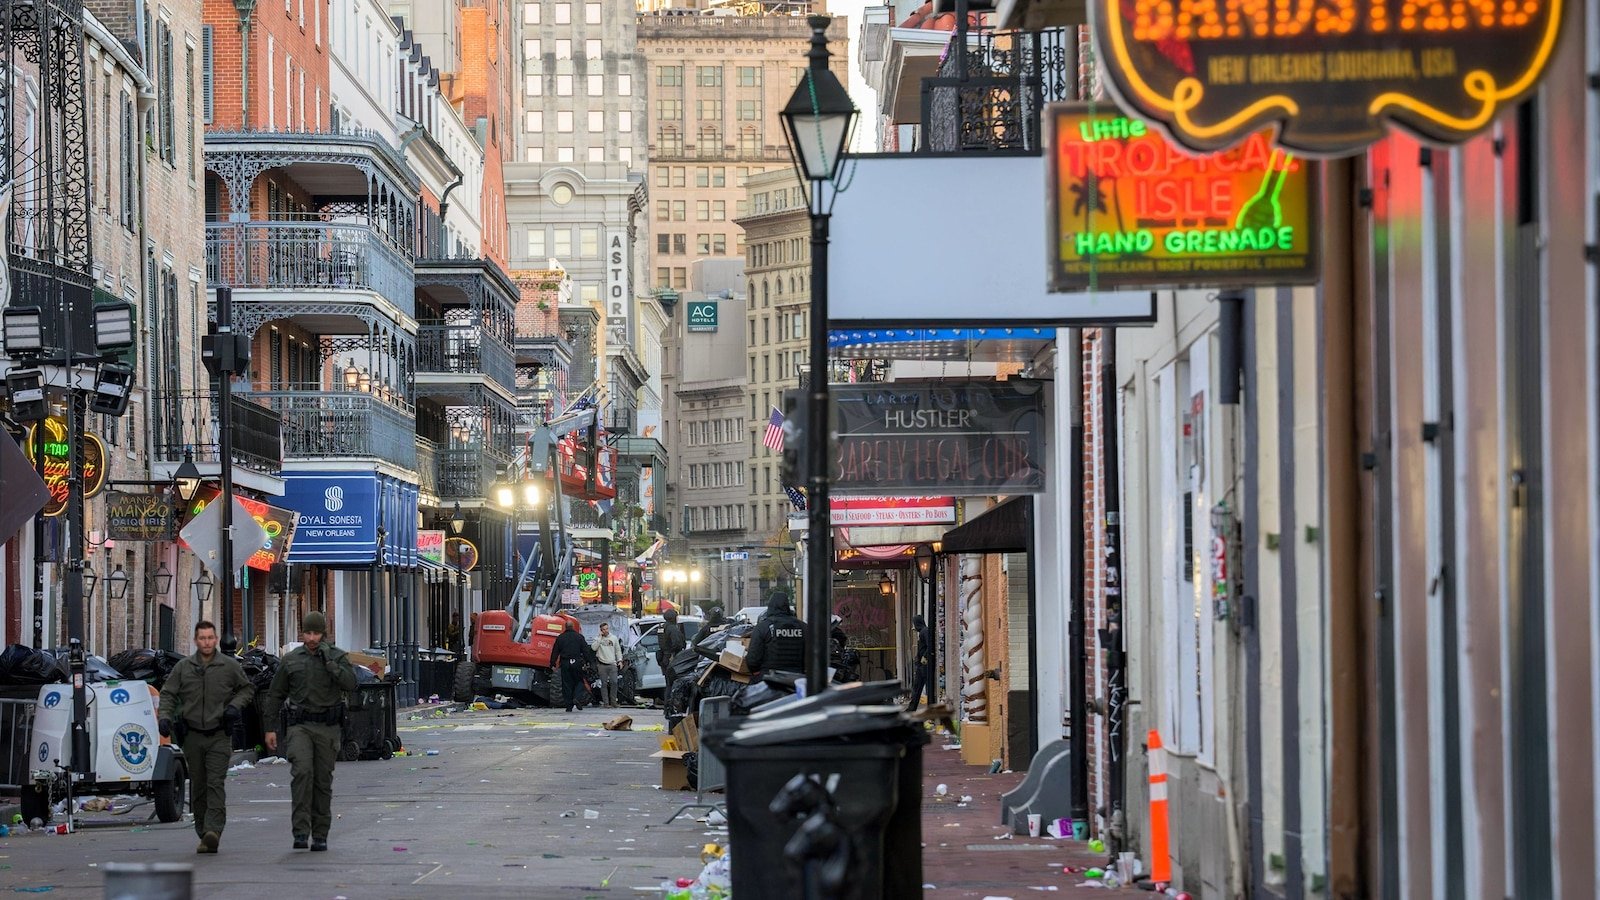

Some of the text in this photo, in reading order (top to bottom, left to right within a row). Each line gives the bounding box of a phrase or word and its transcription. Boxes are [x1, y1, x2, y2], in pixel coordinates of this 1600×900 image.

[1208, 57, 1246, 84] NEW
[1421, 48, 1457, 77] USA
[1138, 180, 1232, 218] ISLE
[1076, 227, 1294, 254] HAND GRENADE
[611, 235, 622, 315] ASTOR
[691, 305, 715, 318] AC
[867, 393, 919, 406] LARRY
[49, 444, 69, 456] TAP
[915, 439, 976, 481] LEGAL
[982, 438, 1031, 479] CLUB
[119, 496, 159, 505] MANGO
[110, 504, 169, 518] MANGO
[848, 511, 872, 520] SEAFOOD
[876, 510, 895, 520] STEAKS
[898, 509, 921, 519] OYSTERS
[112, 517, 167, 526] DAIQUIRIS
[298, 515, 363, 525] OYAL SONESTA
[325, 529, 356, 537] ORLEANS
[776, 628, 802, 638] POLICE
[504, 674, 520, 684] 4X4
